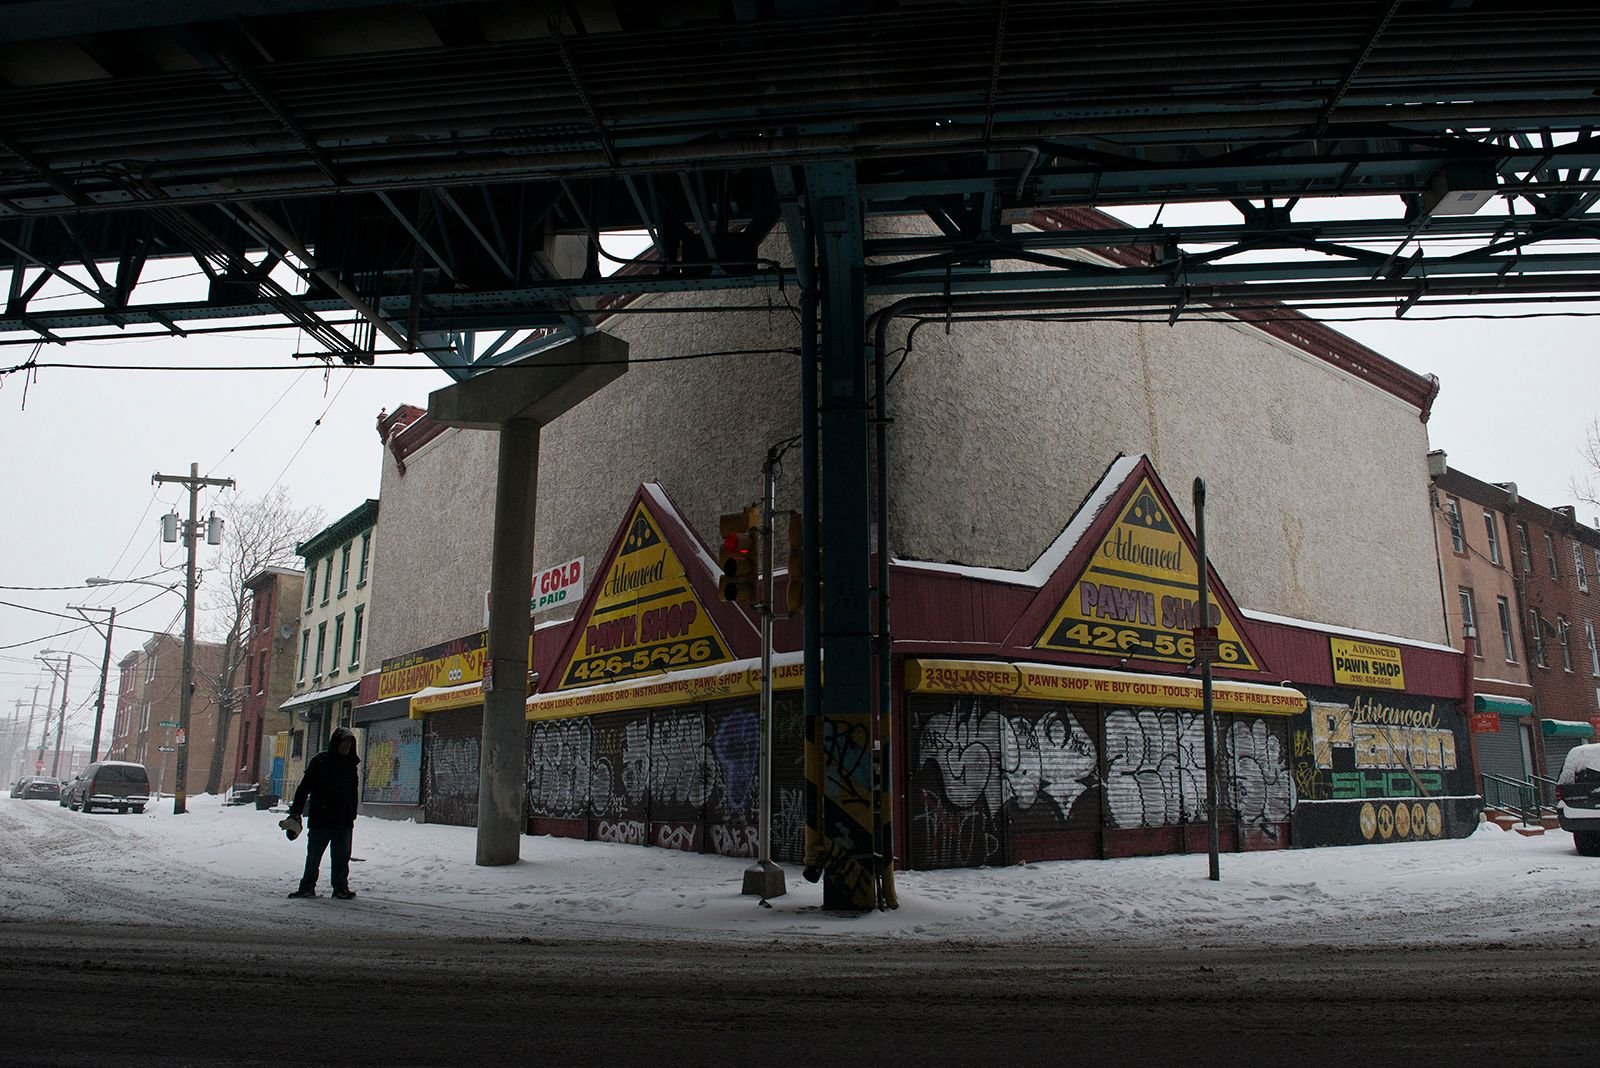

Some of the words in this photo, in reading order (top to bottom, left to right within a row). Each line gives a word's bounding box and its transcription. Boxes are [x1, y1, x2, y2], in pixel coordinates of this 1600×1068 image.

[1104, 527, 1184, 571] Advanced
[541, 561, 580, 594] GOLD
[604, 549, 667, 597] Advanced
[540, 590, 567, 606] PAID
[1080, 581, 1156, 626] PAWN
[586, 614, 637, 656] PAWN
[640, 600, 697, 644] SHOP
[1066, 624, 1239, 662] 426-566
[575, 639, 712, 680] 426-5626
[1336, 657, 1369, 674] PAWN
[1372, 661, 1400, 677] SHOP
[1352, 644, 1396, 658] ADVANCED
[540, 701, 554, 710] CASH
[555, 698, 573, 708] LOANS
[576, 692, 614, 706] COMPRAMOS
[616, 690, 629, 700] ORO
[633, 680, 689, 698] INSTRUMENTOS
[694, 676, 717, 688] PAWN
[718, 672, 742, 686] SHOP
[926, 668, 959, 682] 2301
[962, 670, 1010, 684] JASPER
[1028, 674, 1058, 688] PAWN
[1062, 677, 1089, 690] SHOP
[1094, 680, 1109, 691] WE
[1112, 682, 1130, 692] BUY
[1134, 684, 1157, 694] GOLD
[1163, 686, 1190, 698] TOOLS
[1193, 688, 1230, 700] JEELRY
[1234, 692, 1244, 702] SE
[1246, 693, 1270, 704] HABLA
[1353, 695, 1441, 729] Advanced
[1311, 702, 1457, 770] Pawn
[1331, 772, 1442, 799] SHOP
